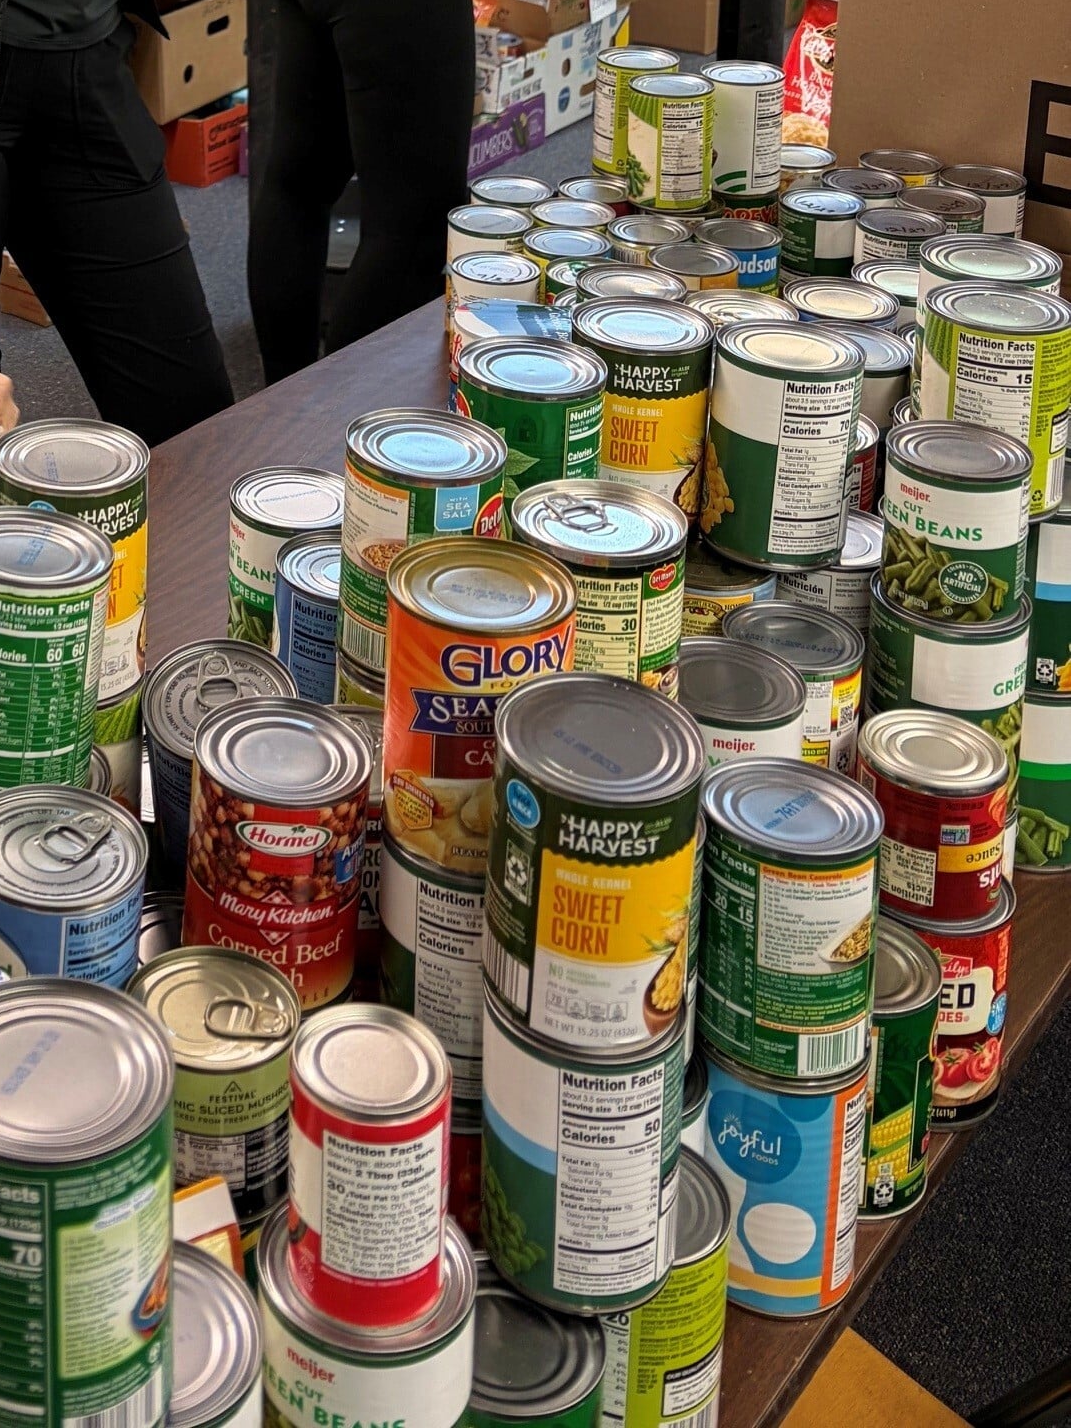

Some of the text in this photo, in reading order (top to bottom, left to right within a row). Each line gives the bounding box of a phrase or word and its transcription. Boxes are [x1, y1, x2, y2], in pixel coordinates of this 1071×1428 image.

[959, 332, 1035, 352] Nutrition Facts
[619, 363, 671, 379] HAPPY
[957, 366, 1033, 385] Calories 15
[613, 375, 682, 393] HARVEST
[787, 380, 854, 396] Nutrition Facts
[570, 402, 603, 422] Nutrition
[612, 403, 664, 418] WHOLE KERNEL
[611, 416, 660, 443] SWEET
[783, 419, 849, 436] Calories 70
[567, 448, 593, 462] Calories
[610, 440, 649, 466] CORN
[84, 499, 132, 525] HAPPY
[442, 509, 473, 520] SALT
[445, 501, 470, 511] SEA
[903, 500, 924, 514] CUT
[480, 512, 496, 532] Del
[916, 515, 983, 542] BEANS
[575, 578, 639, 592] utrition Facts
[784, 576, 824, 595] Nutrición
[943, 578, 981, 592] ARTIFICIAL
[958, 571, 974, 584] NO
[58, 598, 91, 613] Facts
[621, 618, 637, 632] 30
[46, 648, 62, 663] 60
[72, 641, 85, 657] 60
[292, 641, 327, 660] Calories
[440, 627, 575, 688] GLORY
[249, 825, 321, 848] Hormel
[569, 817, 644, 840] HAPPY
[558, 832, 660, 858] HARVEST
[893, 843, 935, 864] Calories 20
[965, 842, 1001, 864] Sauce
[556, 868, 631, 890] WHOLE KERNEL
[906, 882, 933, 896] Facts
[418, 881, 475, 909] Nutrition
[553, 883, 625, 925] SWEET
[890, 884, 932, 906] Nutrition
[219, 892, 267, 922] Mary
[714, 891, 754, 922] 20 15
[67, 907, 126, 936] Nutrition
[418, 931, 464, 956] Calories
[550, 916, 609, 956] CORN
[295, 930, 344, 965] Beef
[544, 1016, 559, 1030] NET
[561, 1019, 576, 1032] WT
[562, 1067, 663, 1095] Nutrition Facts
[209, 1089, 256, 1104] FESTIVAL
[561, 1099, 592, 1113] Serving
[594, 1104, 611, 1113] size
[200, 1100, 246, 1116] SLICED
[561, 1119, 661, 1145] Calories 50
[718, 1117, 782, 1158] joyful
[327, 1134, 423, 1157] Nutrition Facts
[751, 1152, 779, 1166] FOODS
[327, 1179, 345, 1194] 30
[12, 1244, 42, 1268] 70
[288, 1347, 335, 1383] meijer
[295, 1379, 323, 1402] CUT
